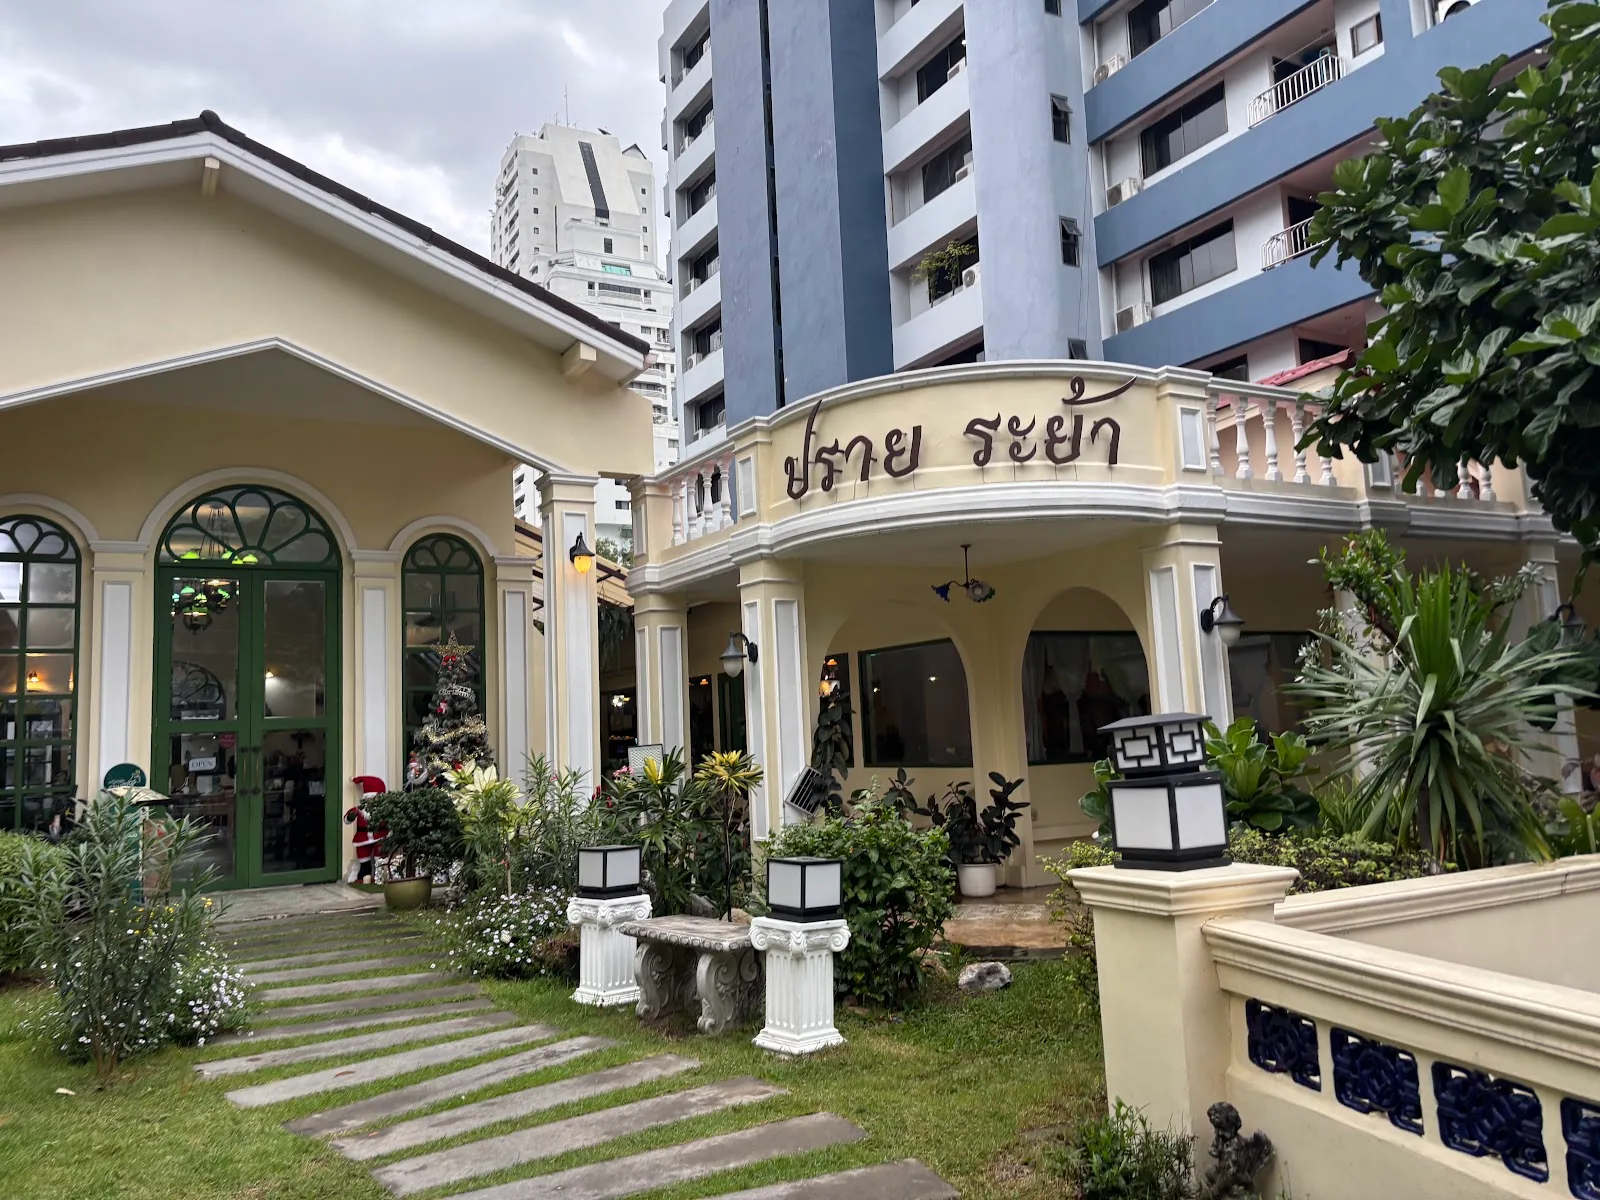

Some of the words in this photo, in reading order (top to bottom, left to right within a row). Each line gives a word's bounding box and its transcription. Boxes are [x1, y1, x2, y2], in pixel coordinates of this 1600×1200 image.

[784, 400, 922, 500] ปราย
[963, 375, 1137, 466] ระย้า
[191, 761, 214, 769] OPEN
